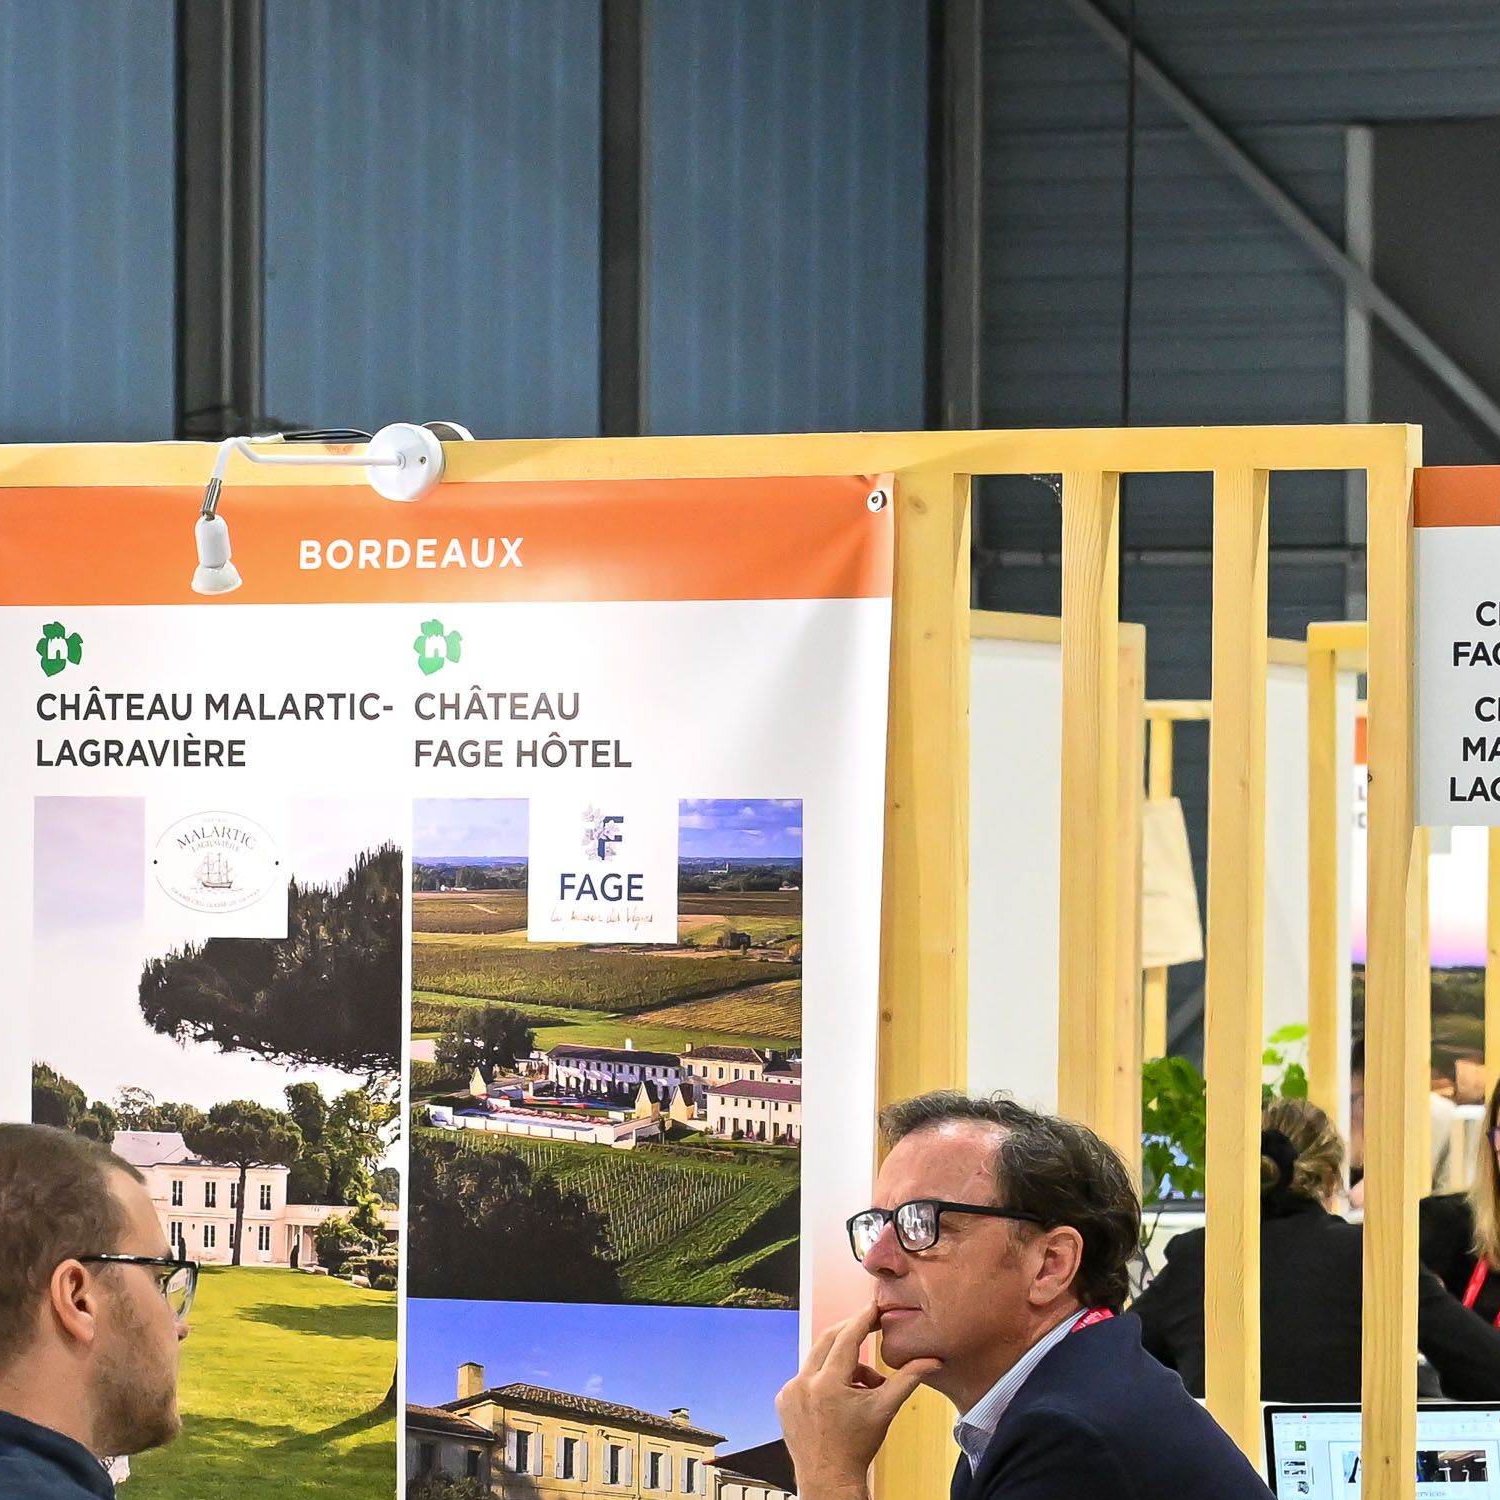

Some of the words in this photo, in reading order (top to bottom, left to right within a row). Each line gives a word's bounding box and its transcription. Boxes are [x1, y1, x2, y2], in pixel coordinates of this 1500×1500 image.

[299, 537, 524, 570] BORDEAUX
[36, 685, 193, 722] CHÂTEAU
[206, 690, 394, 722] MALARTIC-
[414, 683, 581, 722] CHÂTEAU
[36, 728, 247, 768] LAGRAVIÈRE
[414, 738, 505, 769] FAGE
[515, 730, 632, 768] HÔTEL
[177, 826, 257, 850] MALARTIC
[560, 873, 644, 901] FAGE
